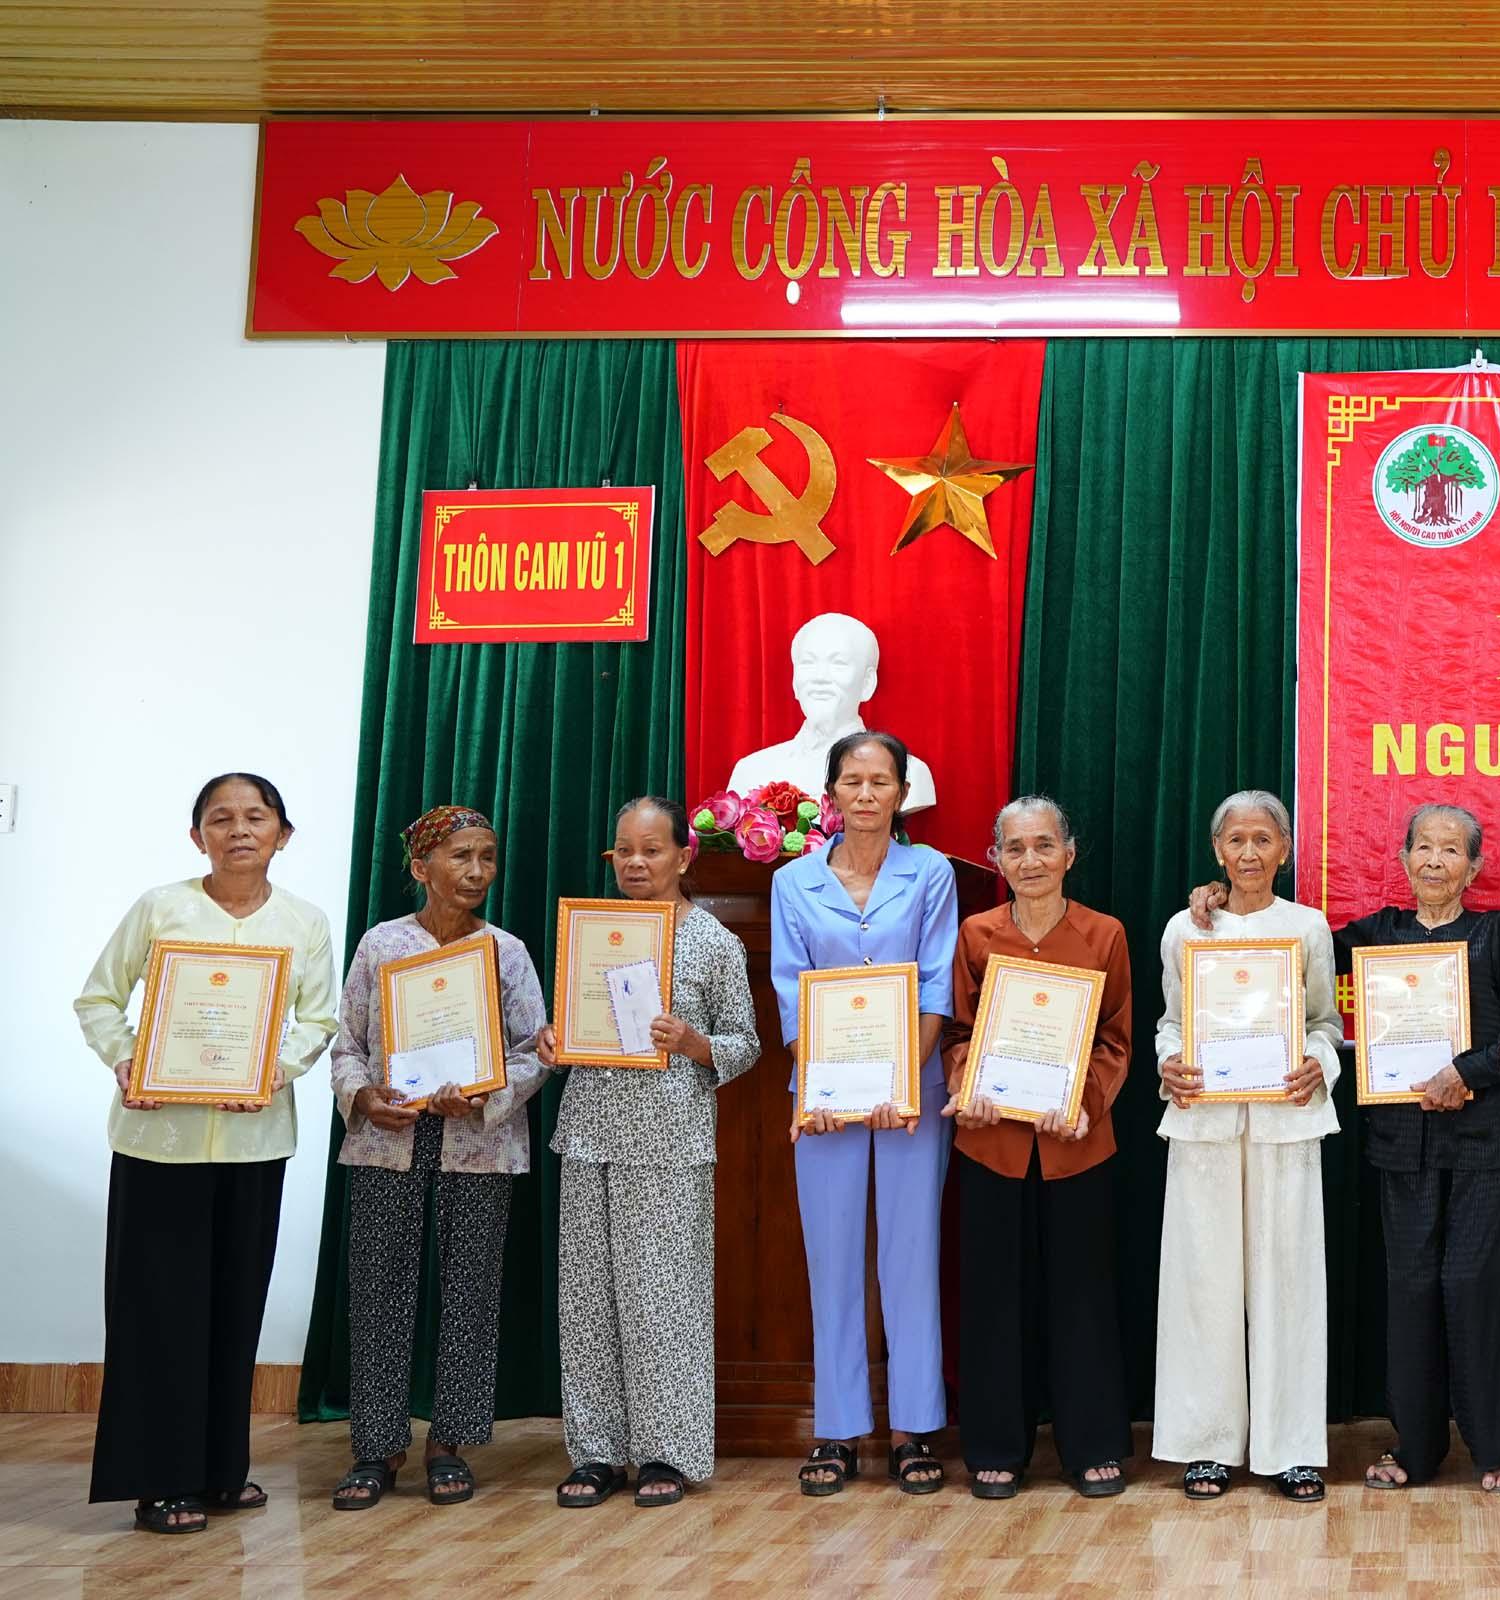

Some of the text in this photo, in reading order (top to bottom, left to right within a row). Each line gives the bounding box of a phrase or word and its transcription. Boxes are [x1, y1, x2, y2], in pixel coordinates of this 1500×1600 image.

[528, 156, 712, 280] NƯỚC
[731, 157, 912, 306] CỘNG
[931, 155, 1065, 278] HÒA
[1077, 160, 1166, 277] XÃ
[1182, 157, 1301, 303] HỘI
[1321, 147, 1462, 279] CHỦ
[443, 531, 625, 593] THÔN CAM VŨ 1
